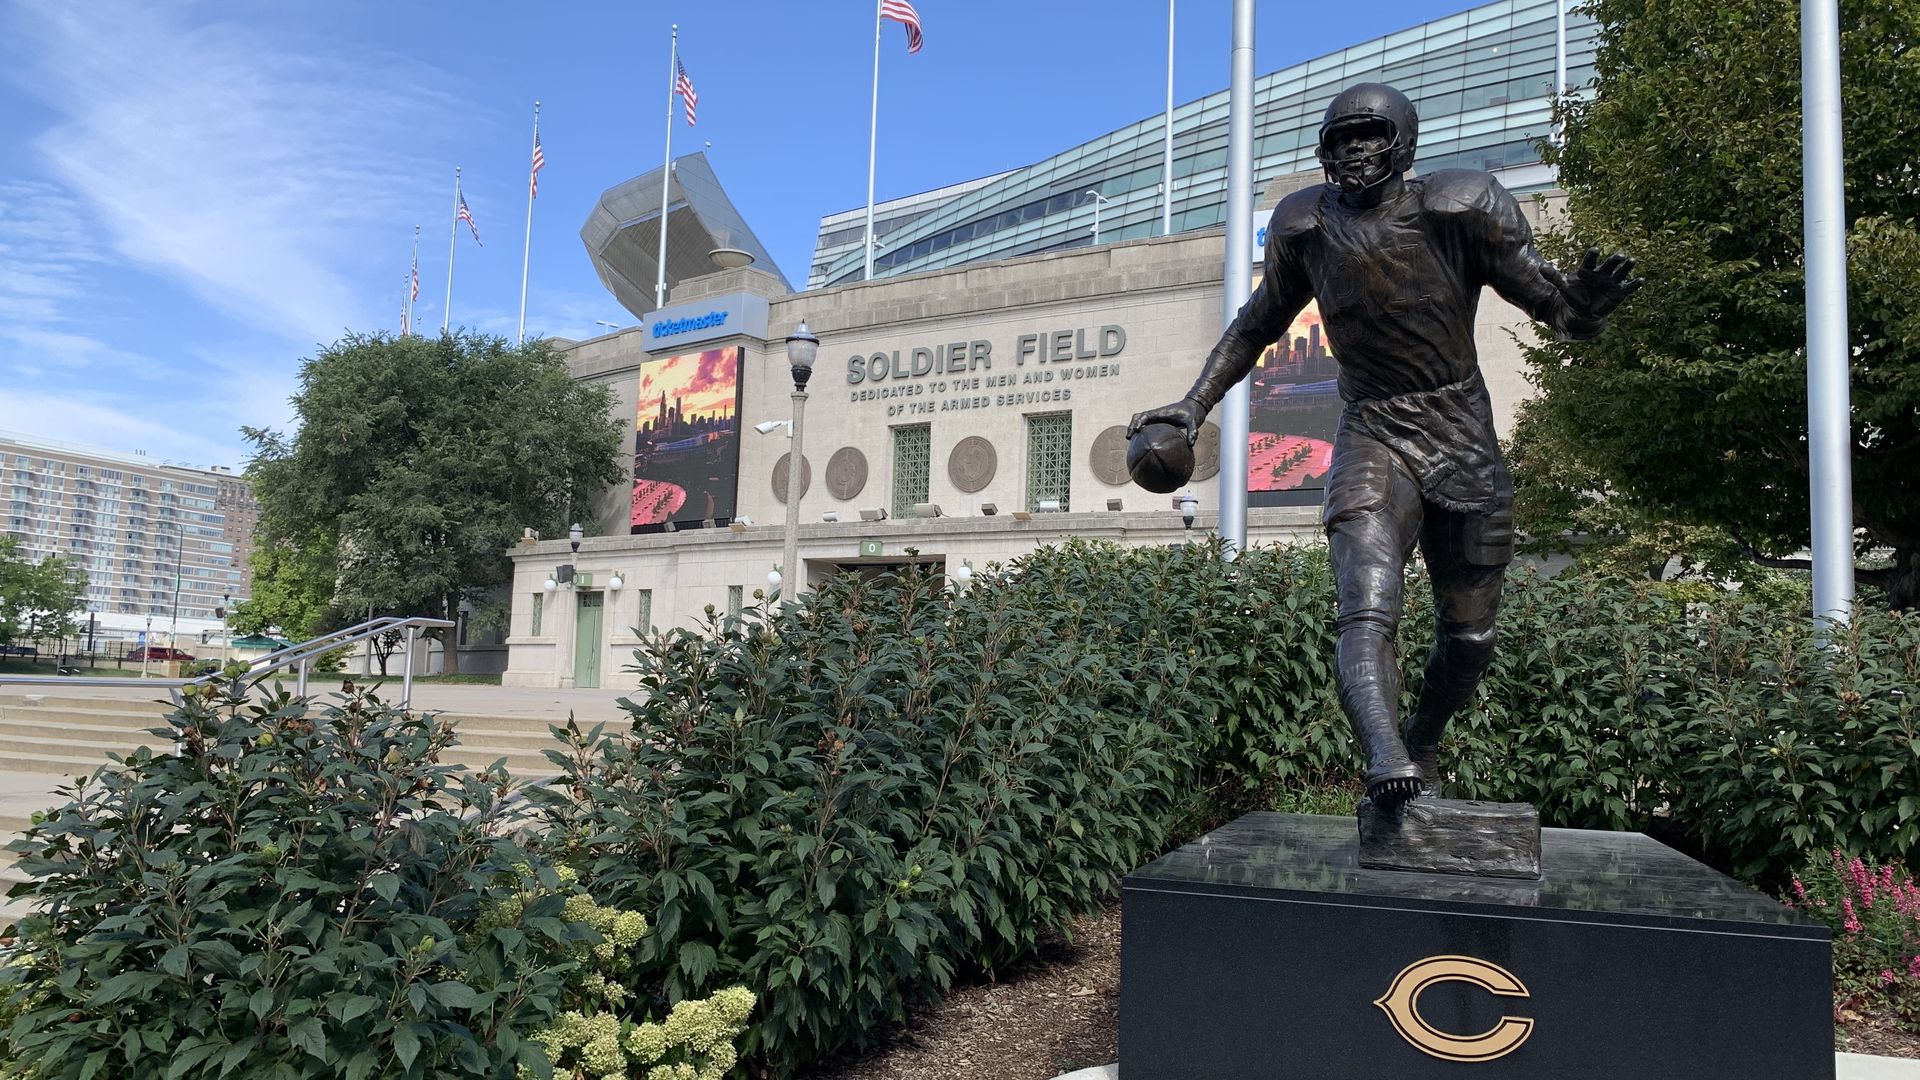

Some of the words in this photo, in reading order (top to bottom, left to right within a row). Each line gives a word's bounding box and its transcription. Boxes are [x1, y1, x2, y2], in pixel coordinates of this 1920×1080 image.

[652, 311, 728, 338] ticketmaster
[847, 340, 992, 384] SOLDIER
[1016, 325, 1126, 366] FIELD
[851, 384, 923, 402] DEDICATED
[929, 382, 947, 393] TO
[953, 379, 980, 391] THE
[986, 374, 1017, 388] MEN
[1023, 370, 1054, 384] AND
[1060, 364, 1120, 380] WOMEN
[888, 405, 904, 416] OF
[910, 401, 935, 414] THE
[941, 396, 990, 411] ARMED
[996, 389, 1072, 406] SERVICES
[1373, 955, 1534, 1062] C
